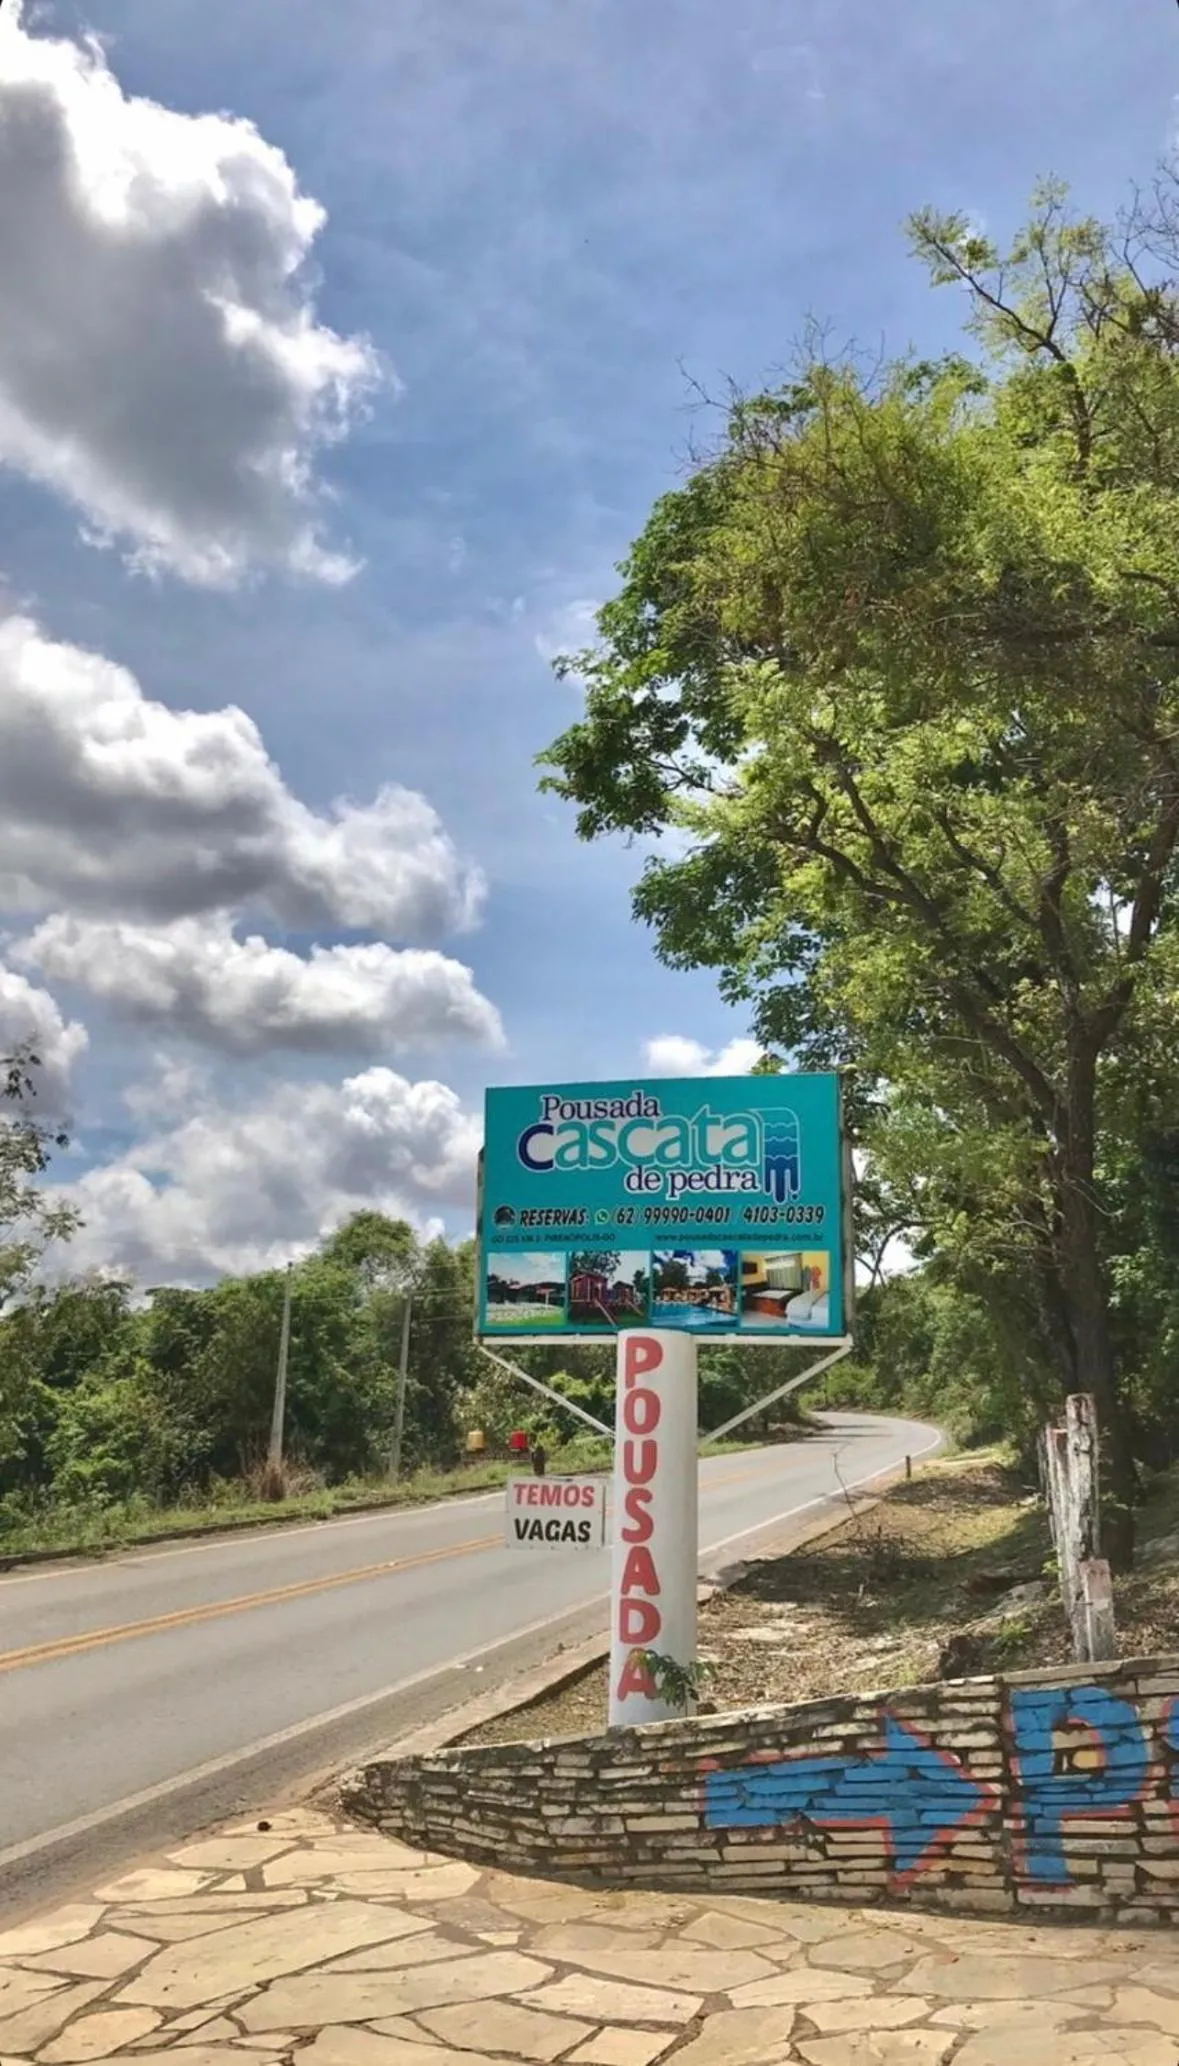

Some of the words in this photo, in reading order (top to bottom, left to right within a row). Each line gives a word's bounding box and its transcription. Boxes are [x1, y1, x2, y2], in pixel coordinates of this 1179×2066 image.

[542, 1091, 660, 1121] Pousada
[626, 1165, 661, 1191] de
[669, 1164, 758, 1200] pedra
[643, 1206, 731, 1224] 99990-0401
[743, 1206, 825, 1224] 4103-0339
[513, 1483, 595, 1508] TEMOS
[513, 1517, 592, 1543] VAGAS
[616, 1336, 664, 1702] POUSADA
